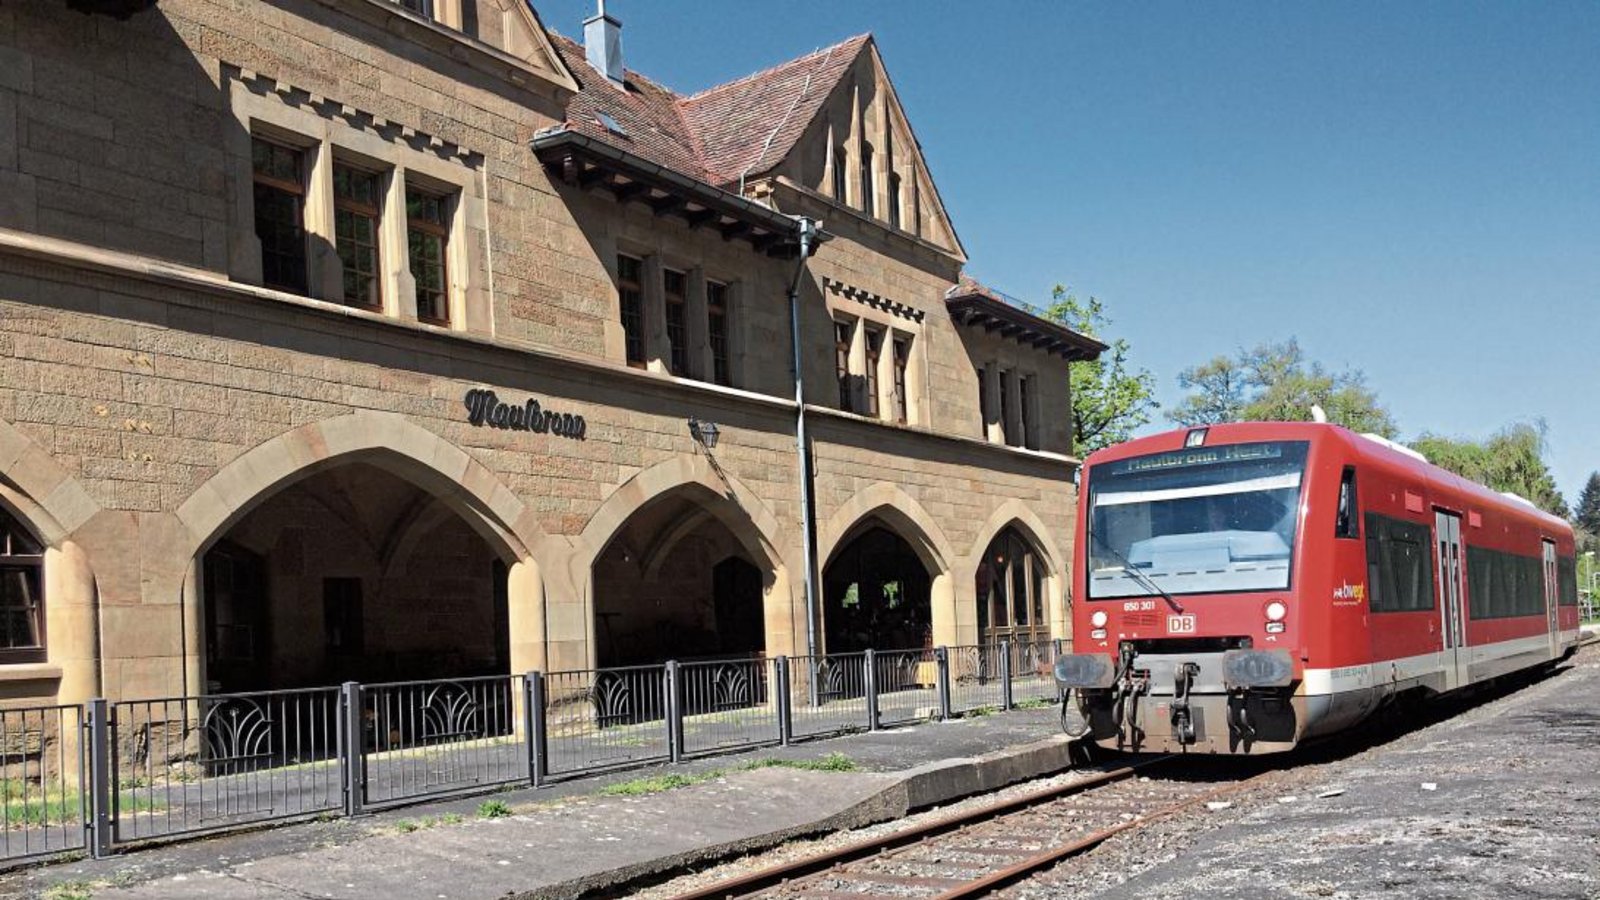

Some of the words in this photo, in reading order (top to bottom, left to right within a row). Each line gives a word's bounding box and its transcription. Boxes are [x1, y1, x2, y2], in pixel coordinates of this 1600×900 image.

[464, 388, 587, 441] Maulbronn
[1123, 602, 1140, 612] 650
[1140, 601, 1156, 611] 301
[1170, 616, 1194, 632] DB
